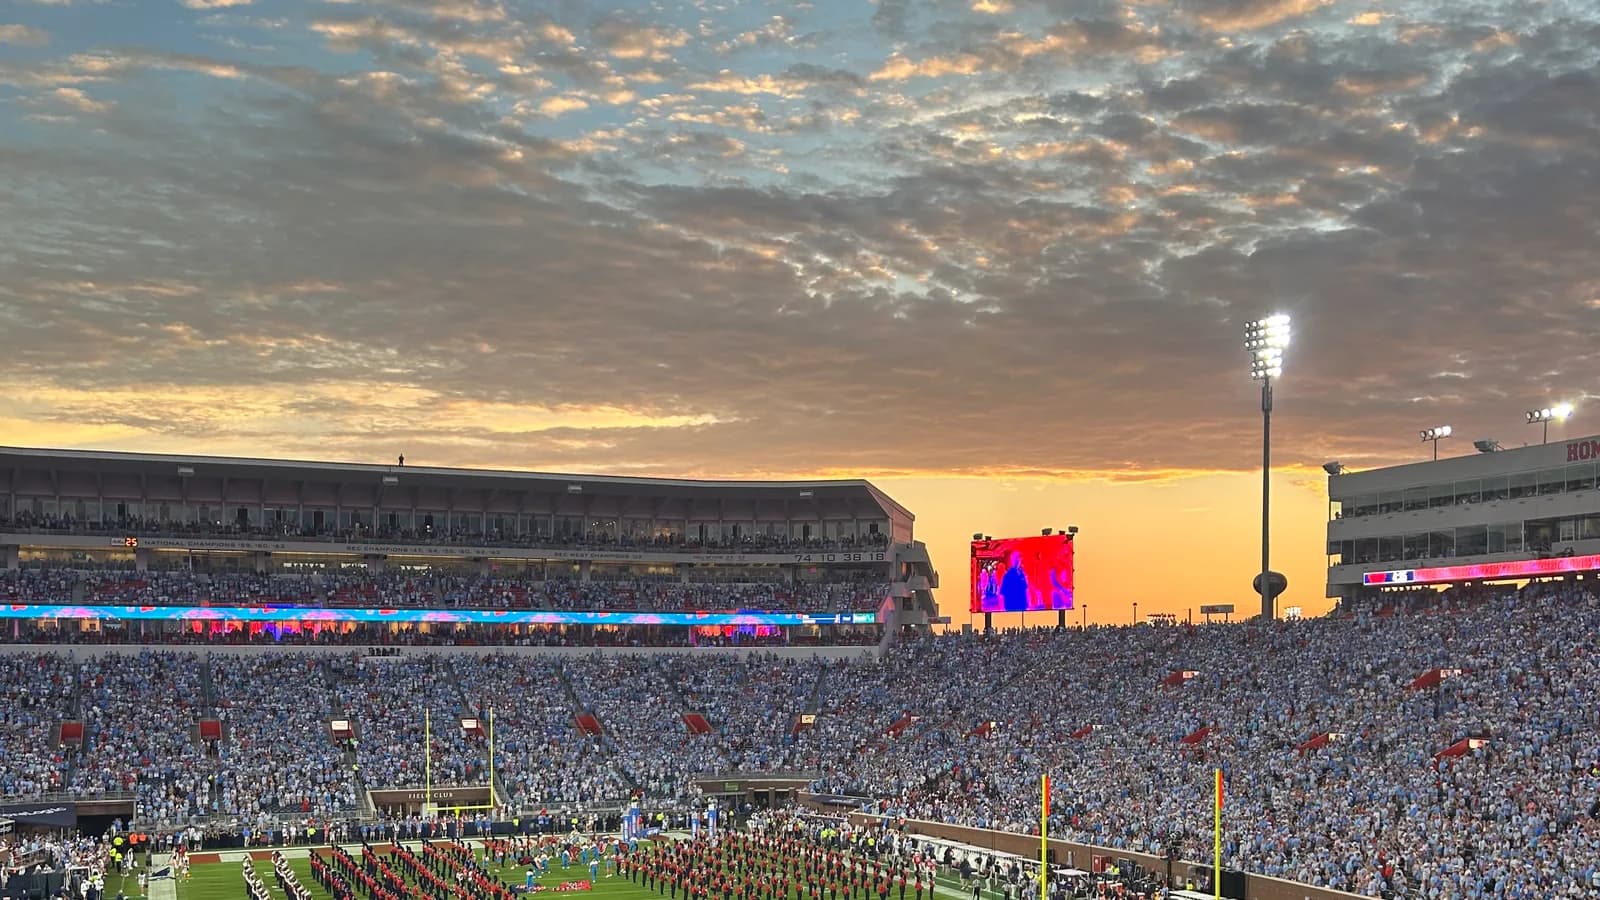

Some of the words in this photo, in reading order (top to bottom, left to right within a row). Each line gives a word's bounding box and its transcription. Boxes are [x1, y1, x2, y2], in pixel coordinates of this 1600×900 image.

[125, 537, 138, 547] 25
[795, 554, 811, 562] 74
[822, 554, 835, 562] 10
[843, 553, 862, 561] 38
[870, 553, 884, 561] 18
